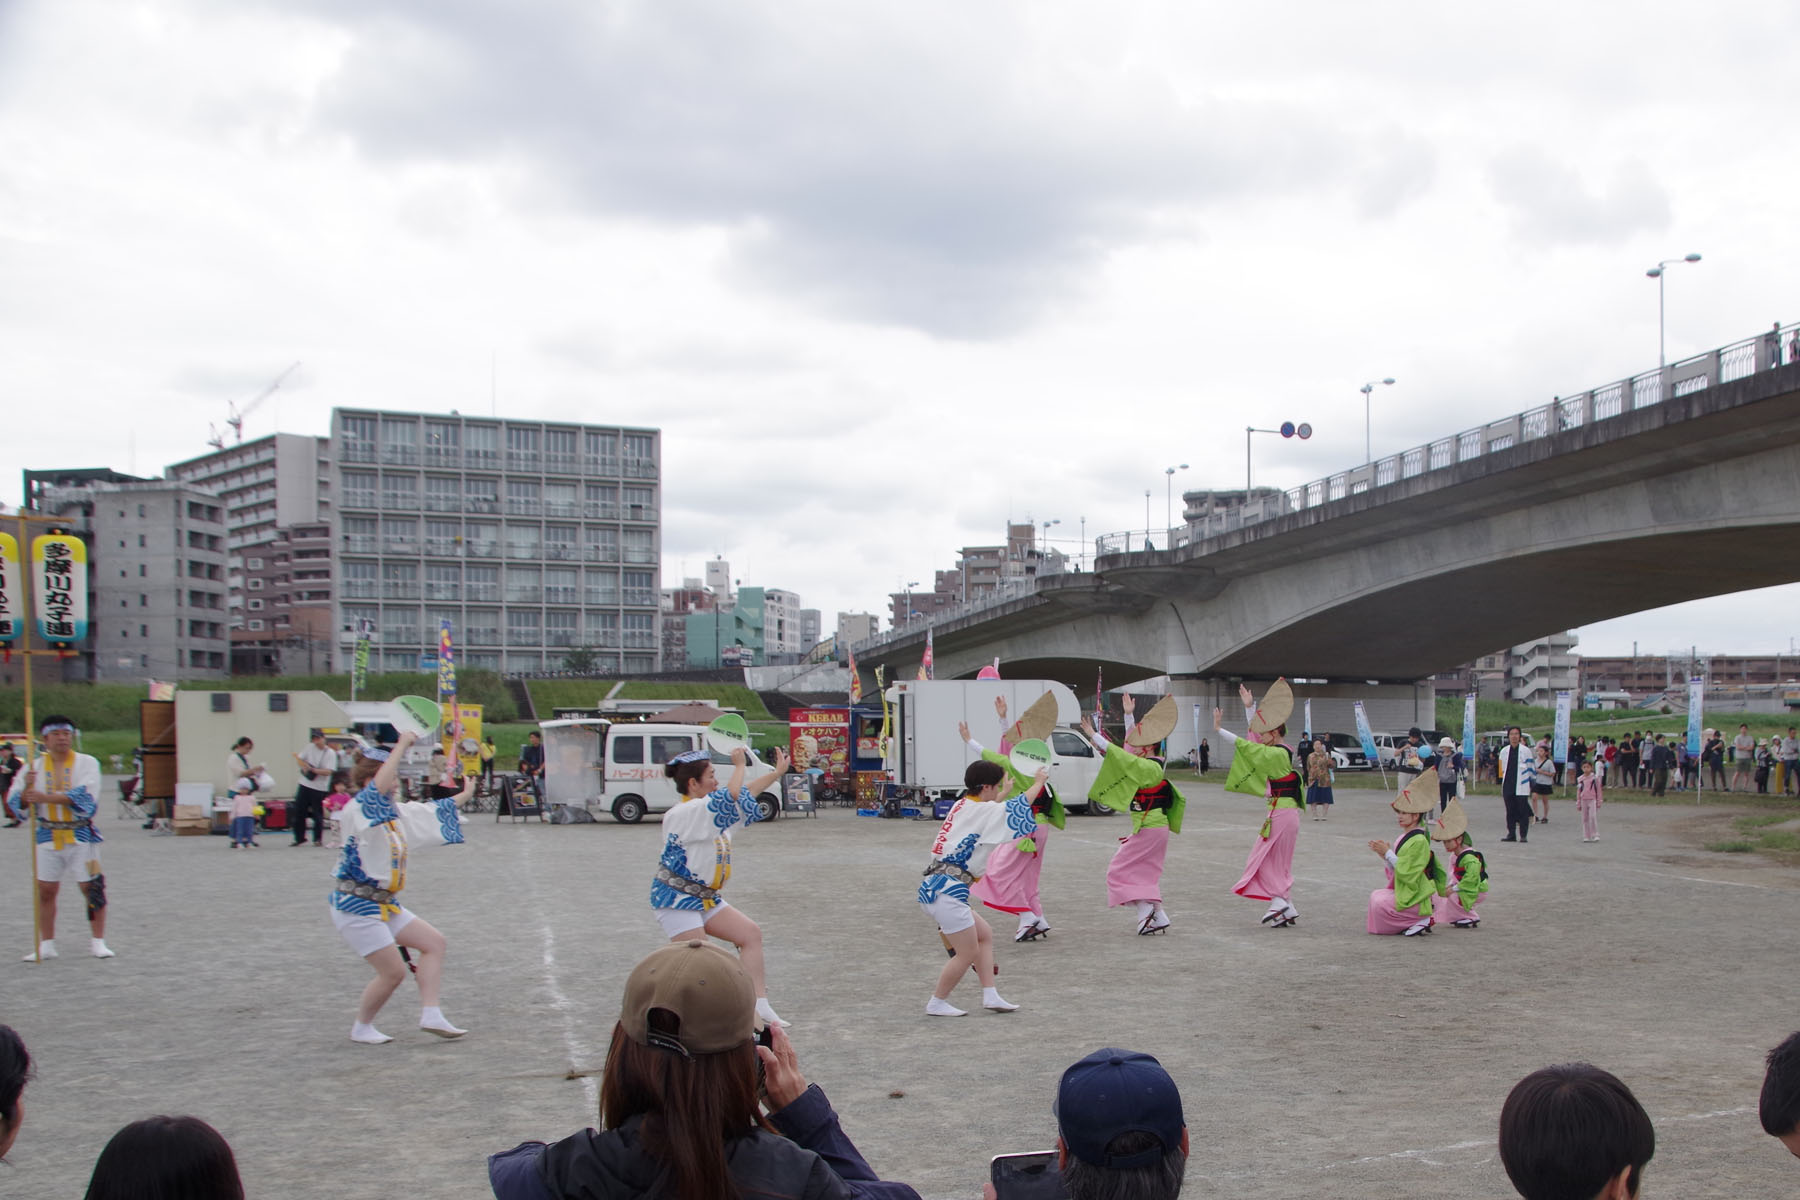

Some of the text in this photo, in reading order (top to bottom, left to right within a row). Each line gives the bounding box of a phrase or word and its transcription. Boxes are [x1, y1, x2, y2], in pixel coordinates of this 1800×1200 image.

[44, 542, 74, 636] 多摩川丸子連
[808, 713, 844, 723] KEBAB
